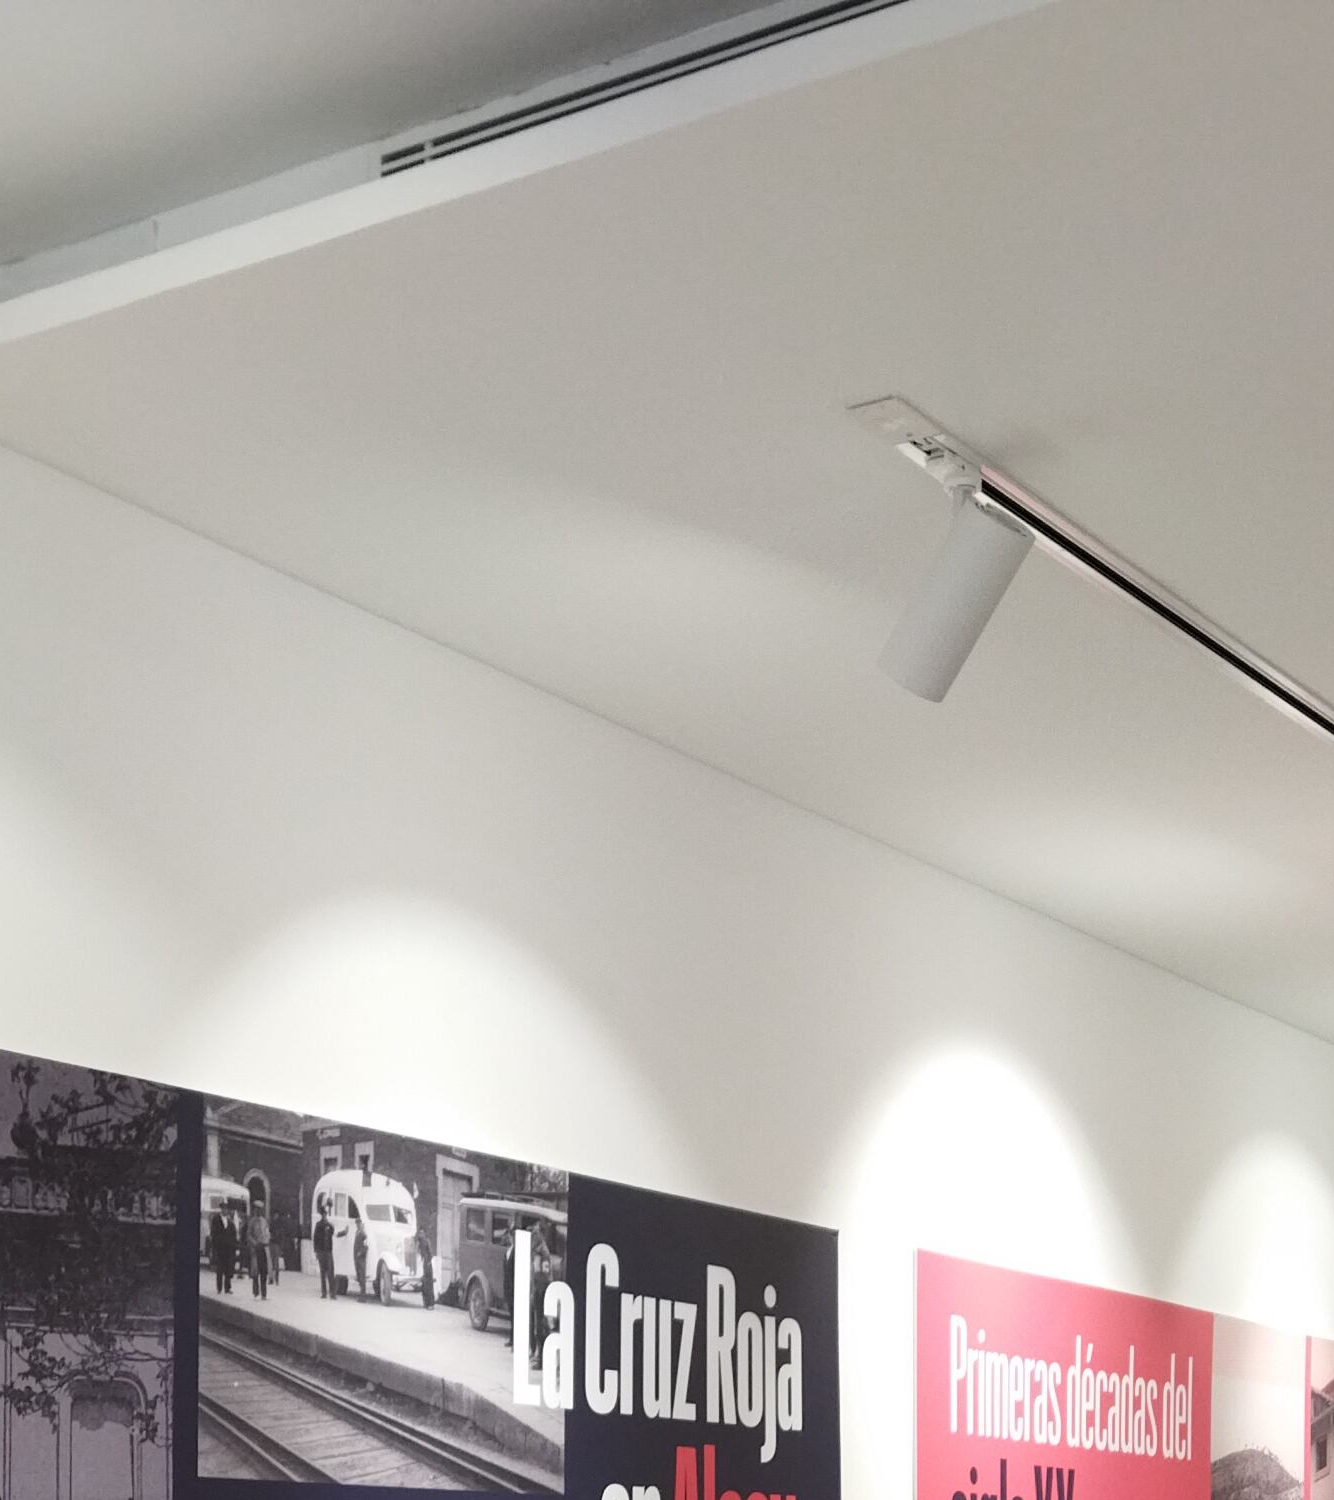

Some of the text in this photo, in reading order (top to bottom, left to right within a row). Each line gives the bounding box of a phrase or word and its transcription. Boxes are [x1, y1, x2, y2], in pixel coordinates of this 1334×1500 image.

[513, 1230, 802, 1463] La Cruz Roja
[949, 1314, 1193, 1461] Primeras décadas del
